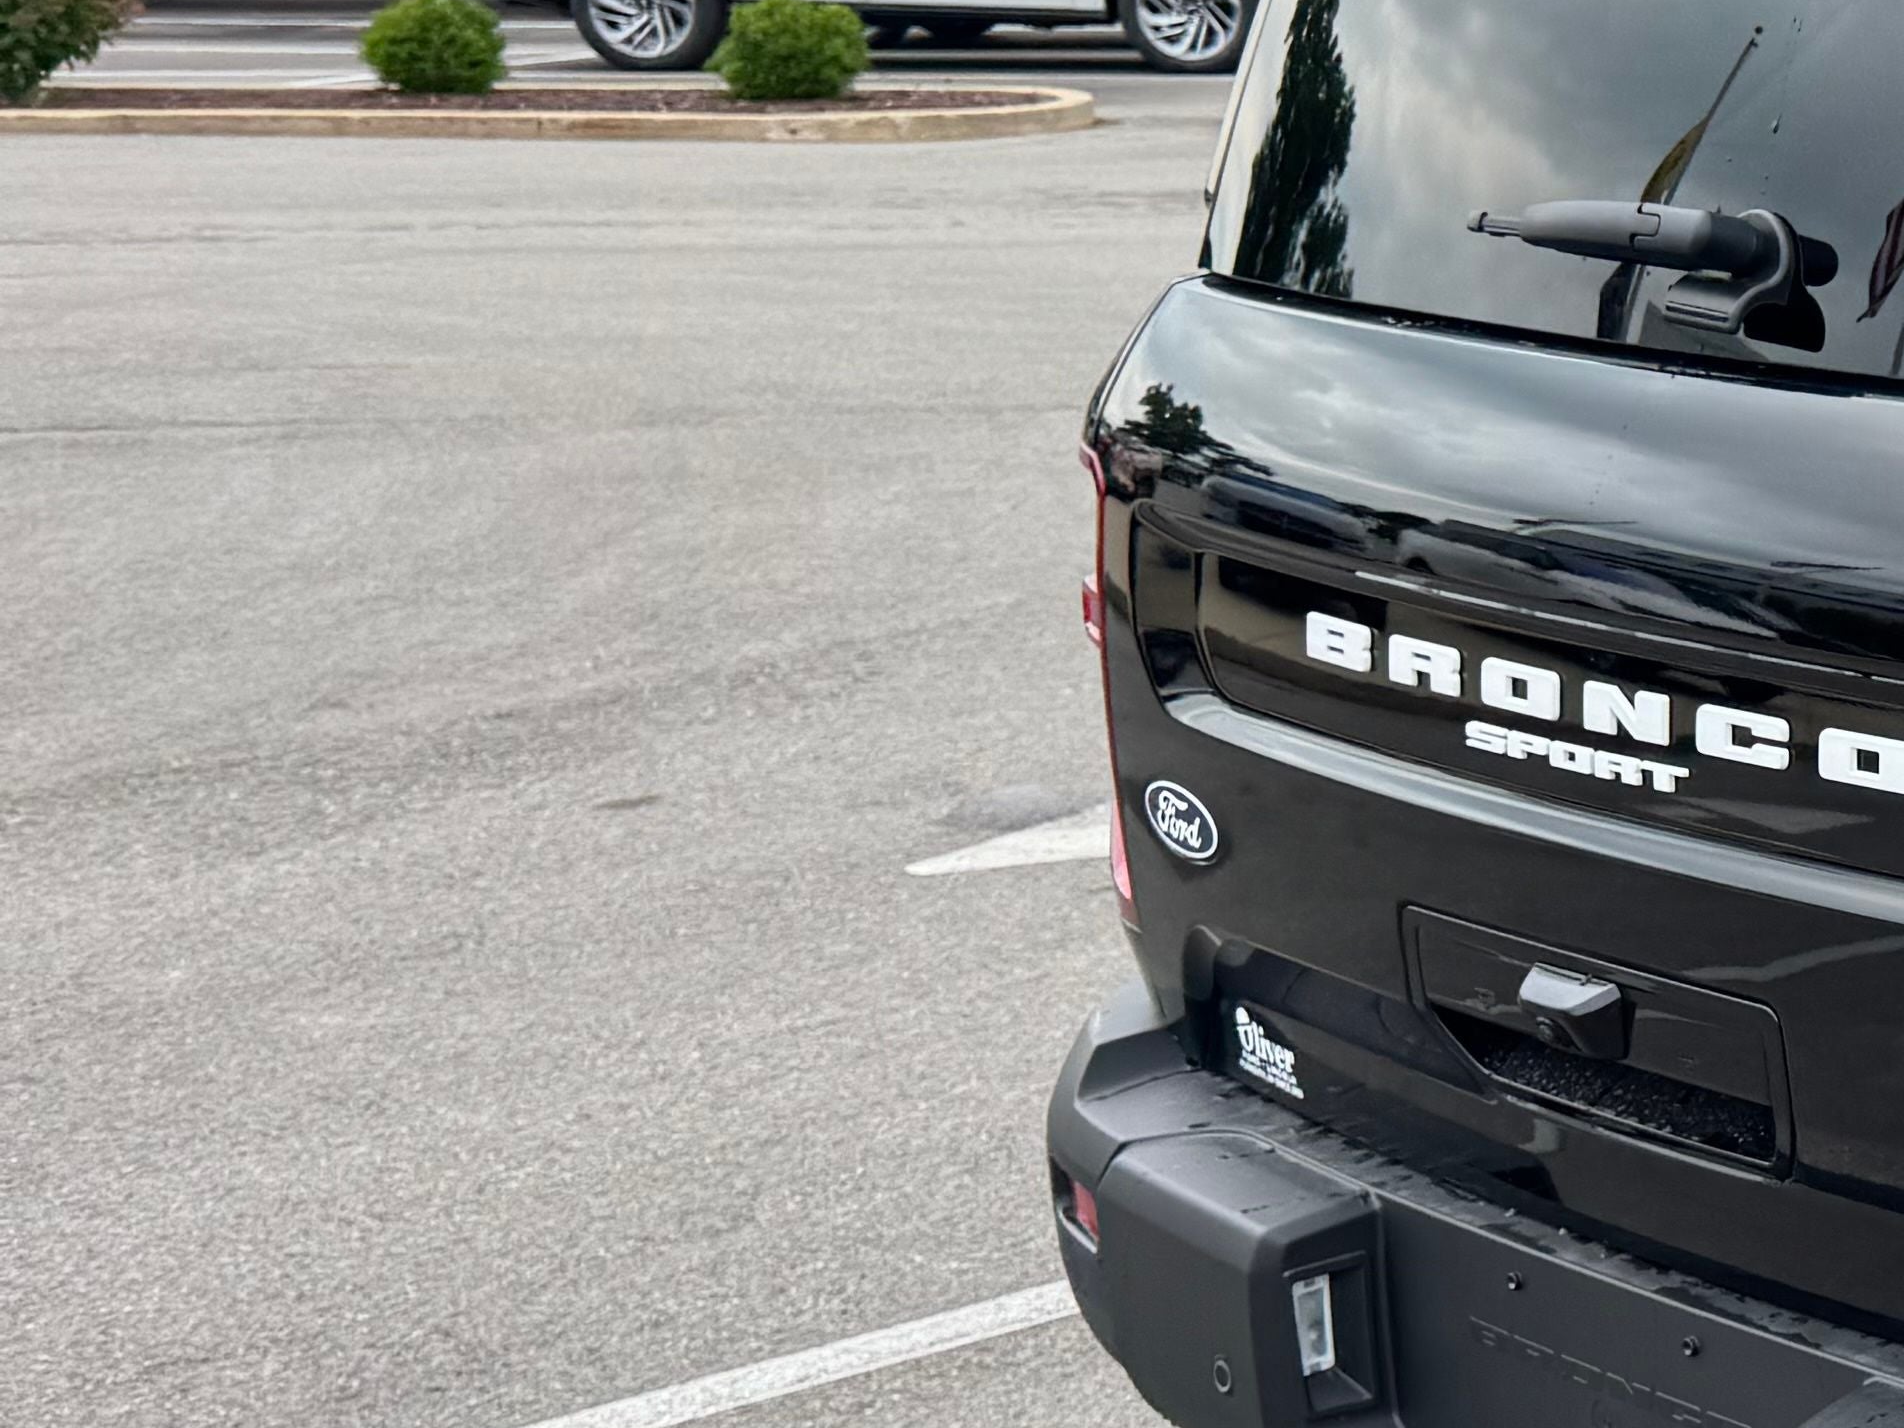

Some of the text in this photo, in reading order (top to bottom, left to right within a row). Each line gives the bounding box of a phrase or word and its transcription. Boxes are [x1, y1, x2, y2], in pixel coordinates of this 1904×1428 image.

[1465, 720, 1691, 794] SPORT
[1156, 789, 1203, 850] Ford
[1235, 1006, 1295, 1073] Oliver
